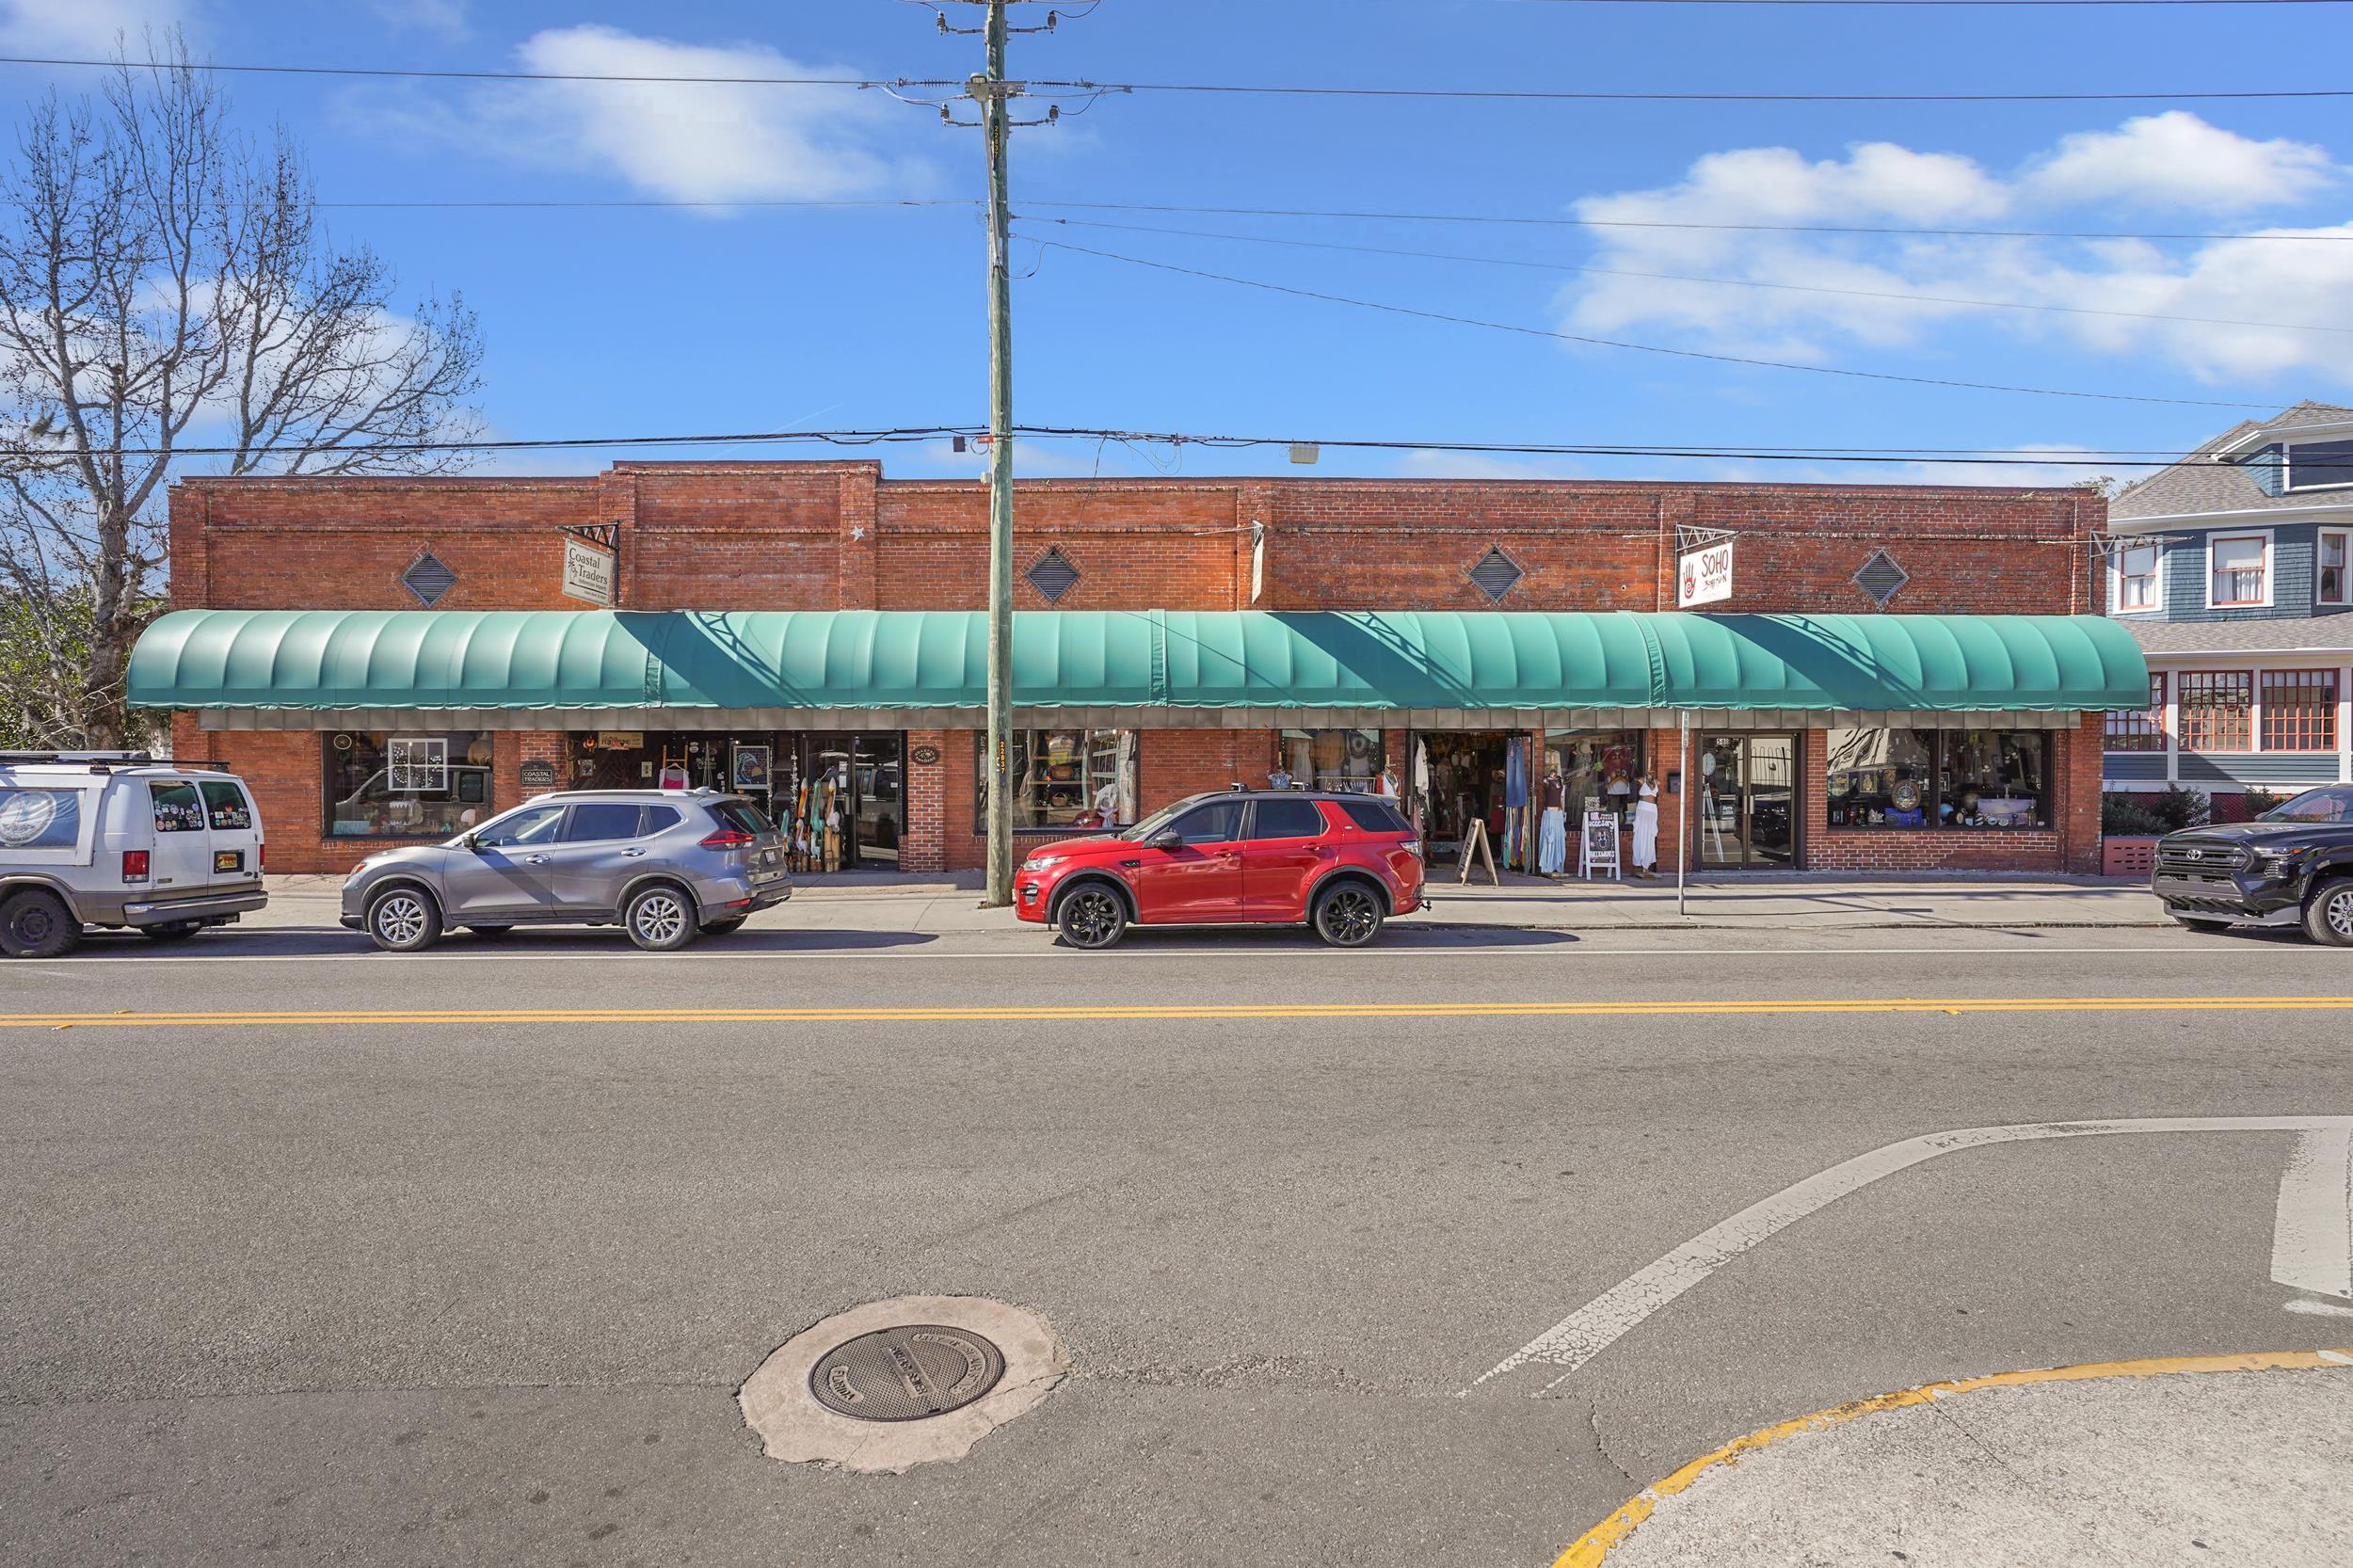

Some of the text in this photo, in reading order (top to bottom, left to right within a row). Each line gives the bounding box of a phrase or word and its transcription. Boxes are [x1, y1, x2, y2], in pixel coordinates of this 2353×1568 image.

[568, 547, 600, 569] Coastal
[1702, 549, 1729, 577] SOHO
[578, 564, 608, 585] Traders
[831, 1369, 856, 1400] FLORIDA
